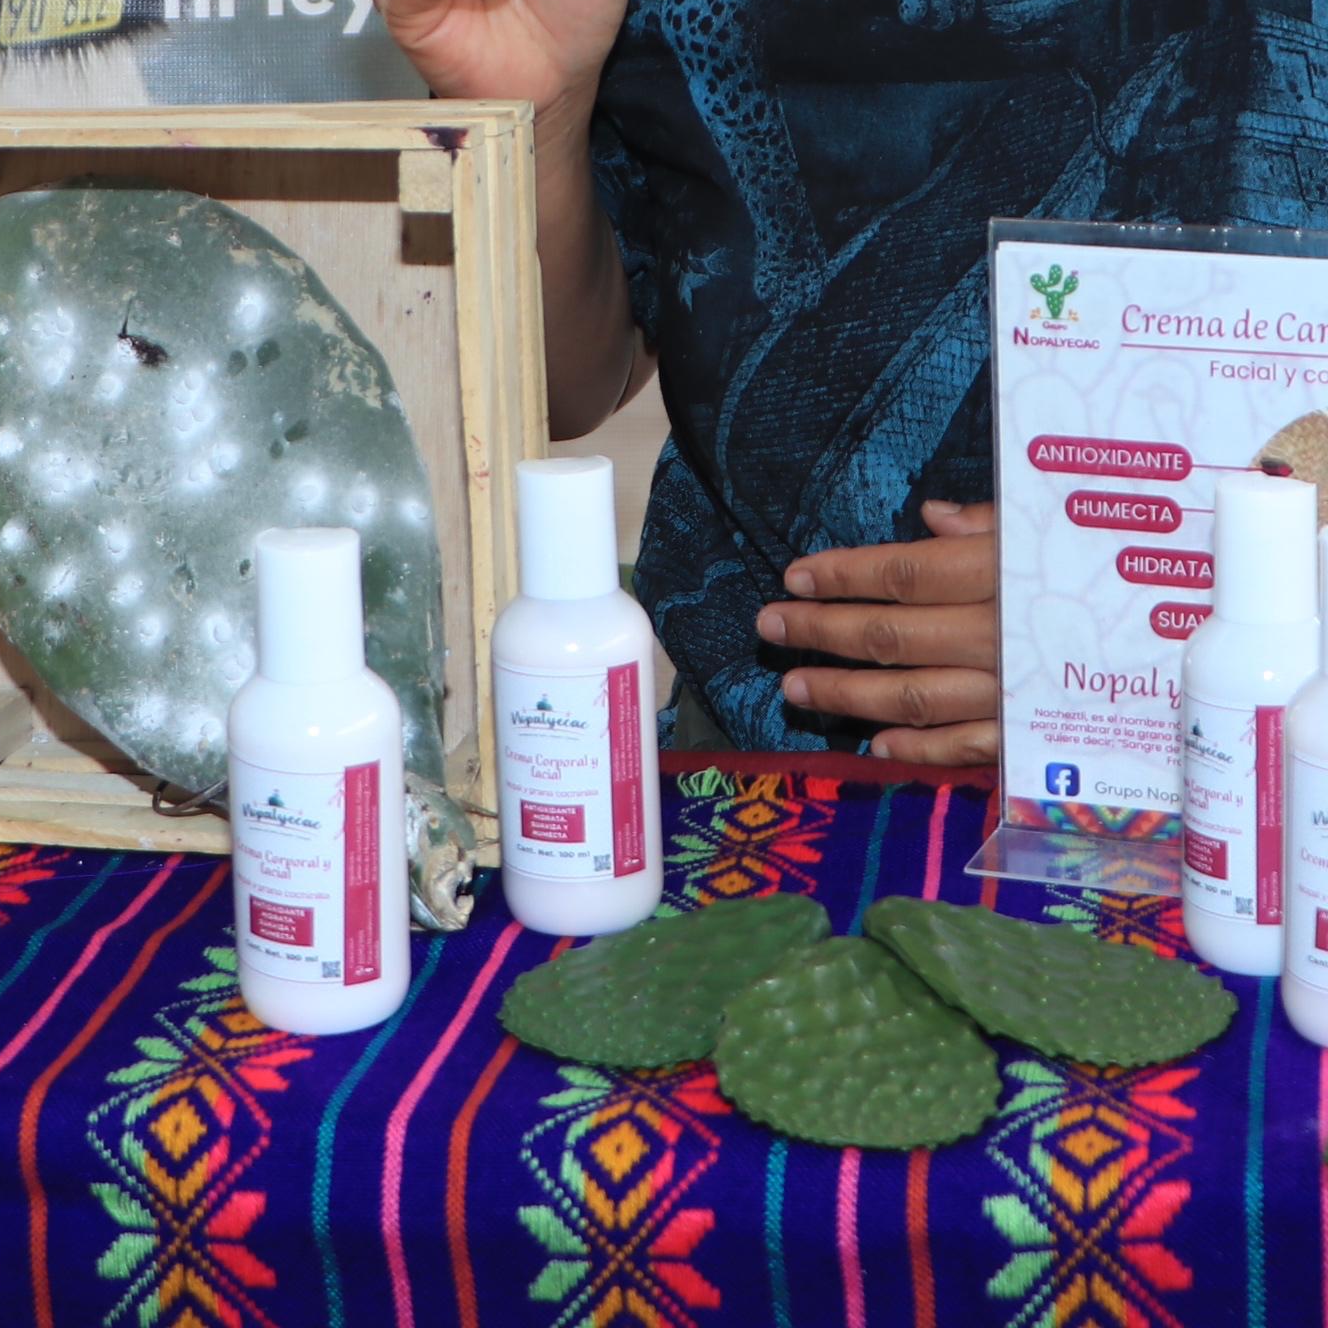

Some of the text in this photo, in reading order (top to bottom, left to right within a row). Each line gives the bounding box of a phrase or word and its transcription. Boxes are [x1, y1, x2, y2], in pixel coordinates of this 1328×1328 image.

[1121, 304, 1225, 338] Crema
[1233, 308, 1269, 340] de
[1210, 360, 1277, 382] Facial
[1284, 366, 1296, 387] y
[1036, 444, 1184, 471] ANTIOXIDANTE
[1073, 499, 1174, 522] HUMECTA
[1124, 555, 1213, 578] HIDRATA
[1063, 661, 1159, 704] Nopal
[1030, 719, 1058, 731] para
[1060, 721, 1110, 735] nombrar
[1124, 727, 1135, 738] la
[1137, 730, 1172, 742] grana
[1091, 714, 1104, 723] es
[1107, 713, 1118, 723] el
[1121, 715, 1166, 729] nombre
[1044, 732, 1080, 744] quiere
[1165, 743, 1180, 753] de
[535, 753, 588, 771] Corporal
[1094, 781, 1183, 805] Grupo Nop
